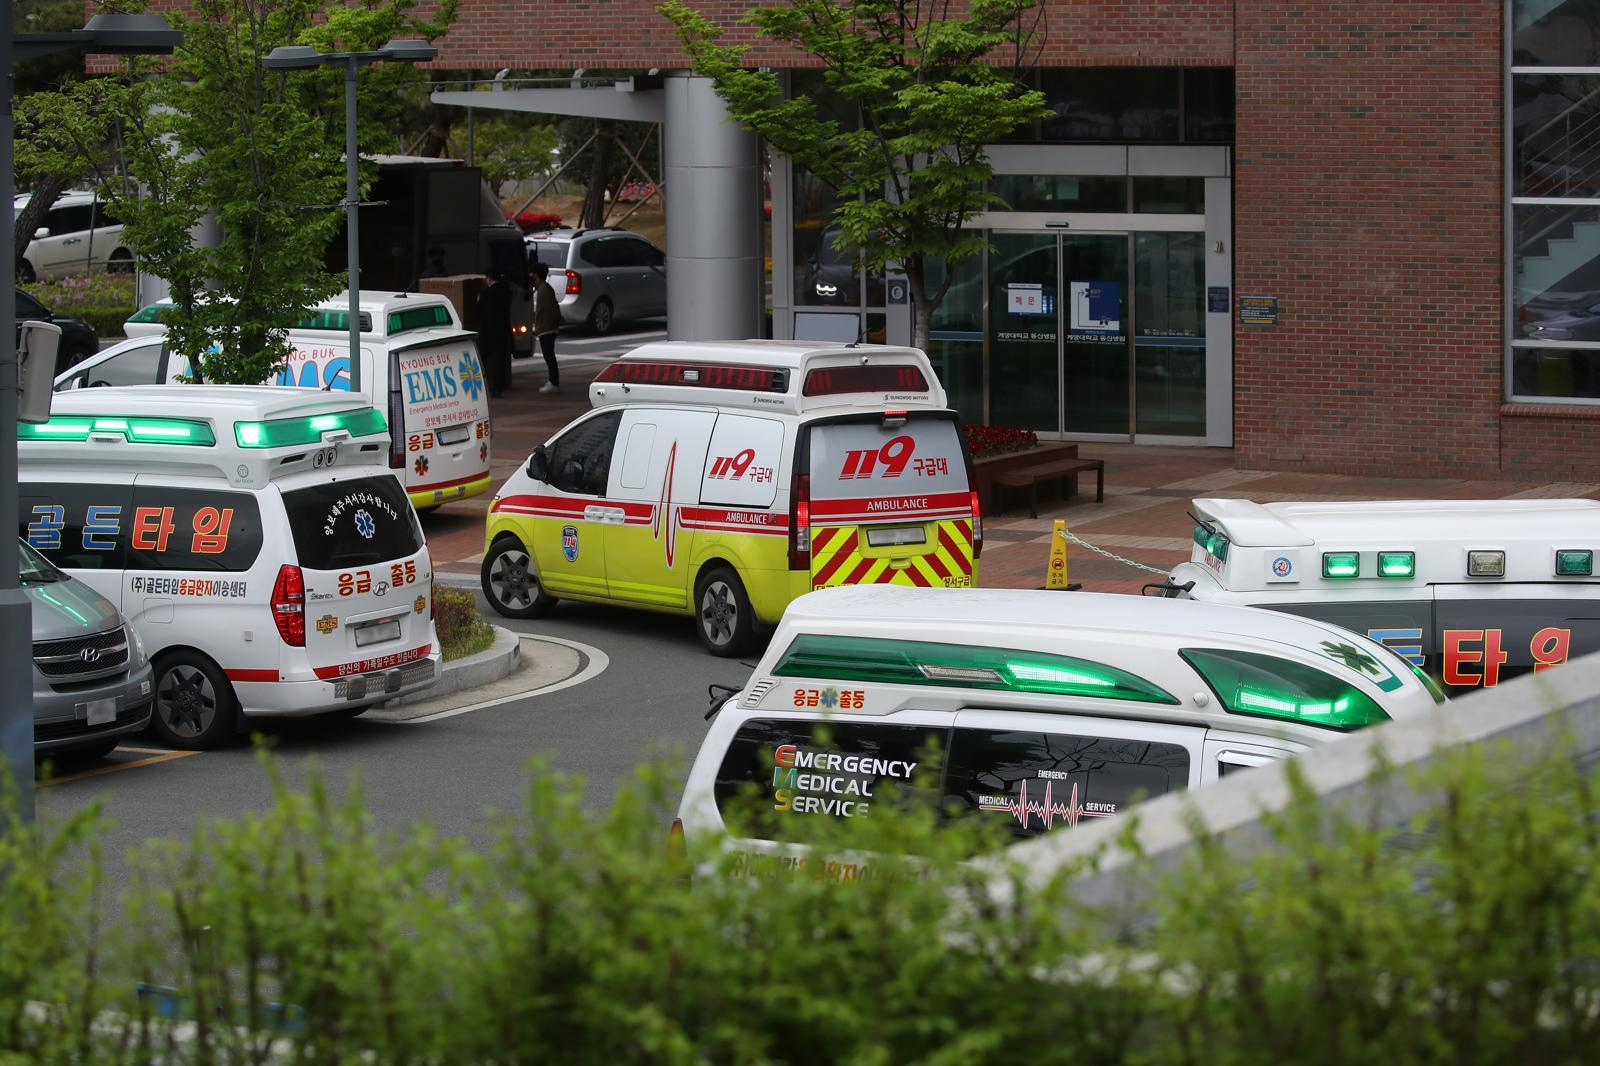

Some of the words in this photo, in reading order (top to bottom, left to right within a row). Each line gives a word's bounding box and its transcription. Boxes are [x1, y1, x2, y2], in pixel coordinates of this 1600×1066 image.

[312, 347, 336, 359] BUK
[400, 356, 435, 370] KYOUNG
[437, 353, 452, 364] BUK
[404, 365, 458, 404] EMS
[408, 432, 434, 453] 응급
[476, 420, 489, 440] 출동
[708, 448, 756, 480] 119
[749, 466, 774, 483] 구급대
[838, 435, 916, 480] 119
[913, 457, 948, 477] 구급대
[726, 511, 767, 525] AMBULANCE
[866, 498, 929, 512] AMBULANCE
[27, 504, 234, 554] 골든타임
[338, 570, 372, 597] 응급
[391, 560, 417, 588] 출동
[338, 661, 360, 676] 당신의
[397, 648, 418, 662] 있습니다
[793, 688, 819, 707] 응급
[839, 690, 865, 709] 출동
[774, 744, 917, 778] EMERGENCY
[1037, 769, 1068, 780] EMERGENCY
[772, 766, 873, 797] MEDICAL
[774, 788, 870, 818] SERVICE
[978, 795, 1009, 806] MEDICAL
[1085, 802, 1116, 813] SERVICE
